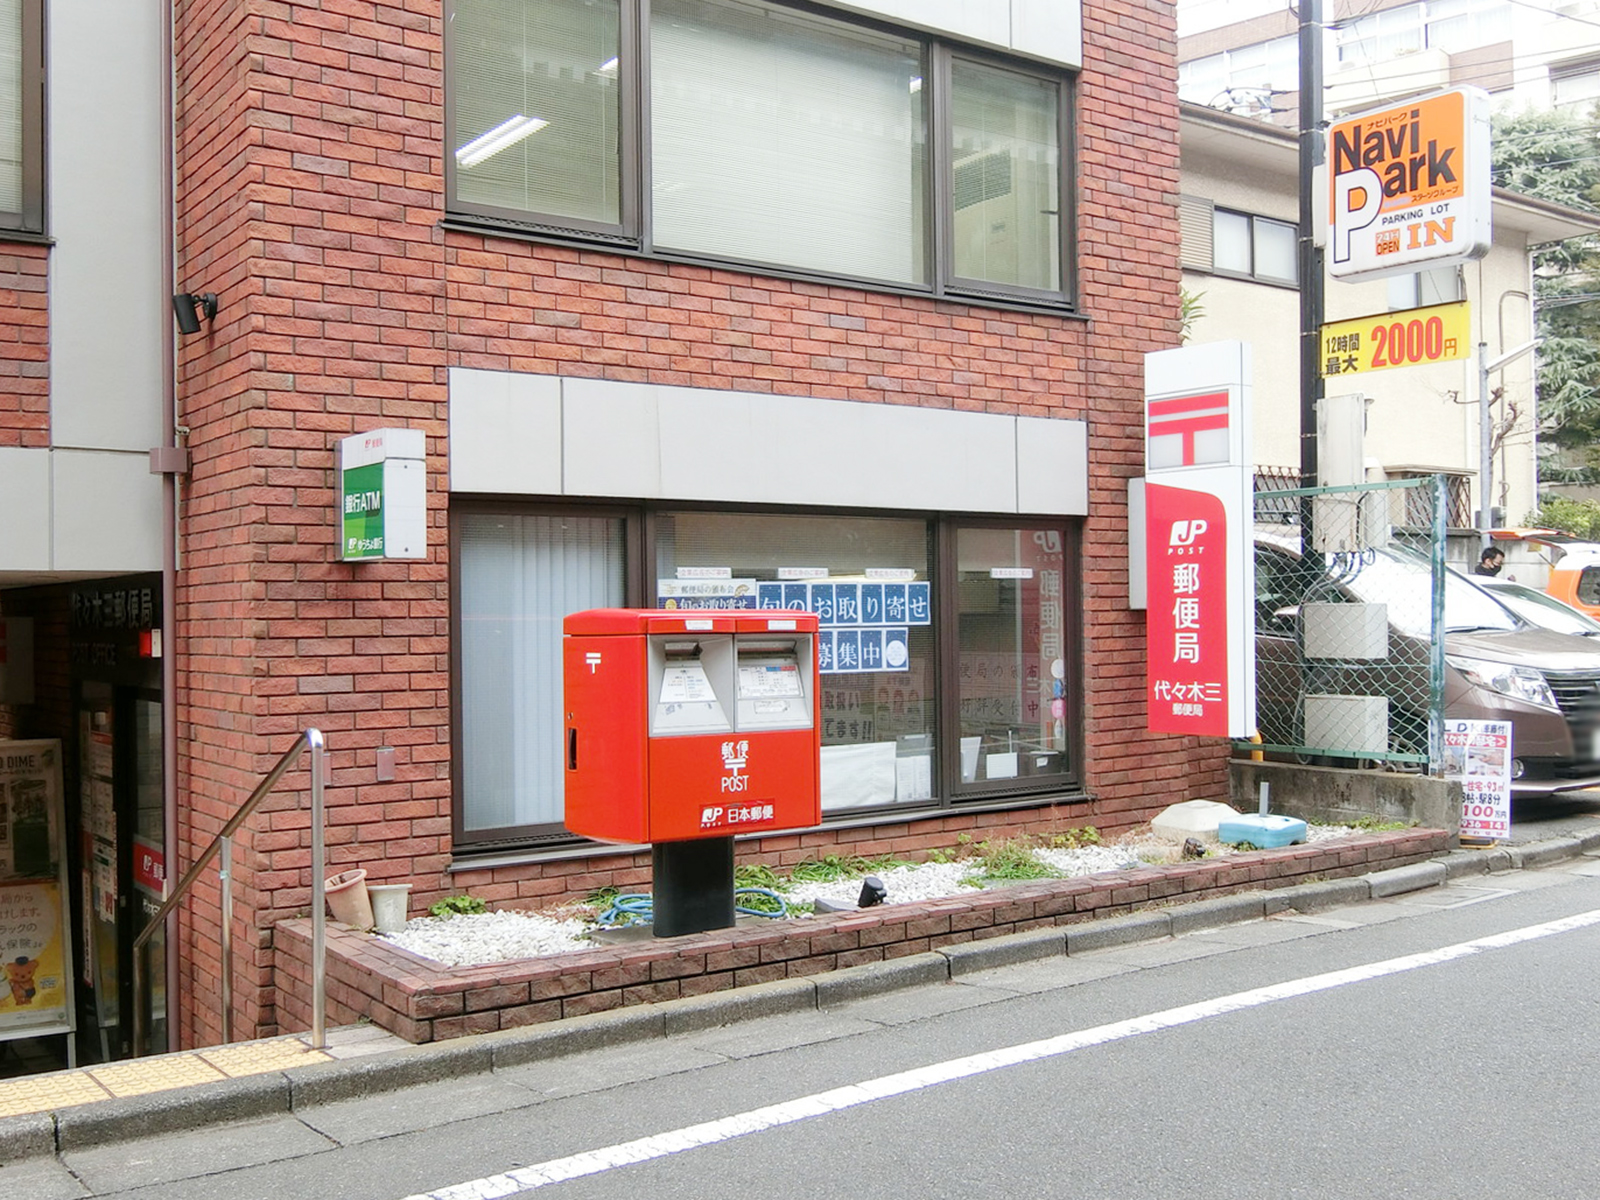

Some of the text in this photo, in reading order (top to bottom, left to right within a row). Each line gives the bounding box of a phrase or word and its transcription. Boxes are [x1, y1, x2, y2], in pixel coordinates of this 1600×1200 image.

[1334, 109, 1420, 174] Navi
[1382, 203, 1450, 226] PARKING LOT
[1407, 216, 1456, 250] IN
[1377, 240, 1400, 255] OPEN
[1326, 316, 1457, 368] 12時間 2000円
[1325, 354, 1359, 375] 最大
[345, 491, 380, 513] 銀行ATM
[1168, 547, 1204, 556] POST
[1172, 563, 1200, 664] 郵便局
[1154, 680, 1222, 702] 代々木三
[1172, 703, 1203, 717] 郵便局
[722, 740, 749, 760] 郵便
[7, 755, 35, 768] DIME
[721, 775, 749, 793] POST
[728, 805, 774, 823] 日本郵便
